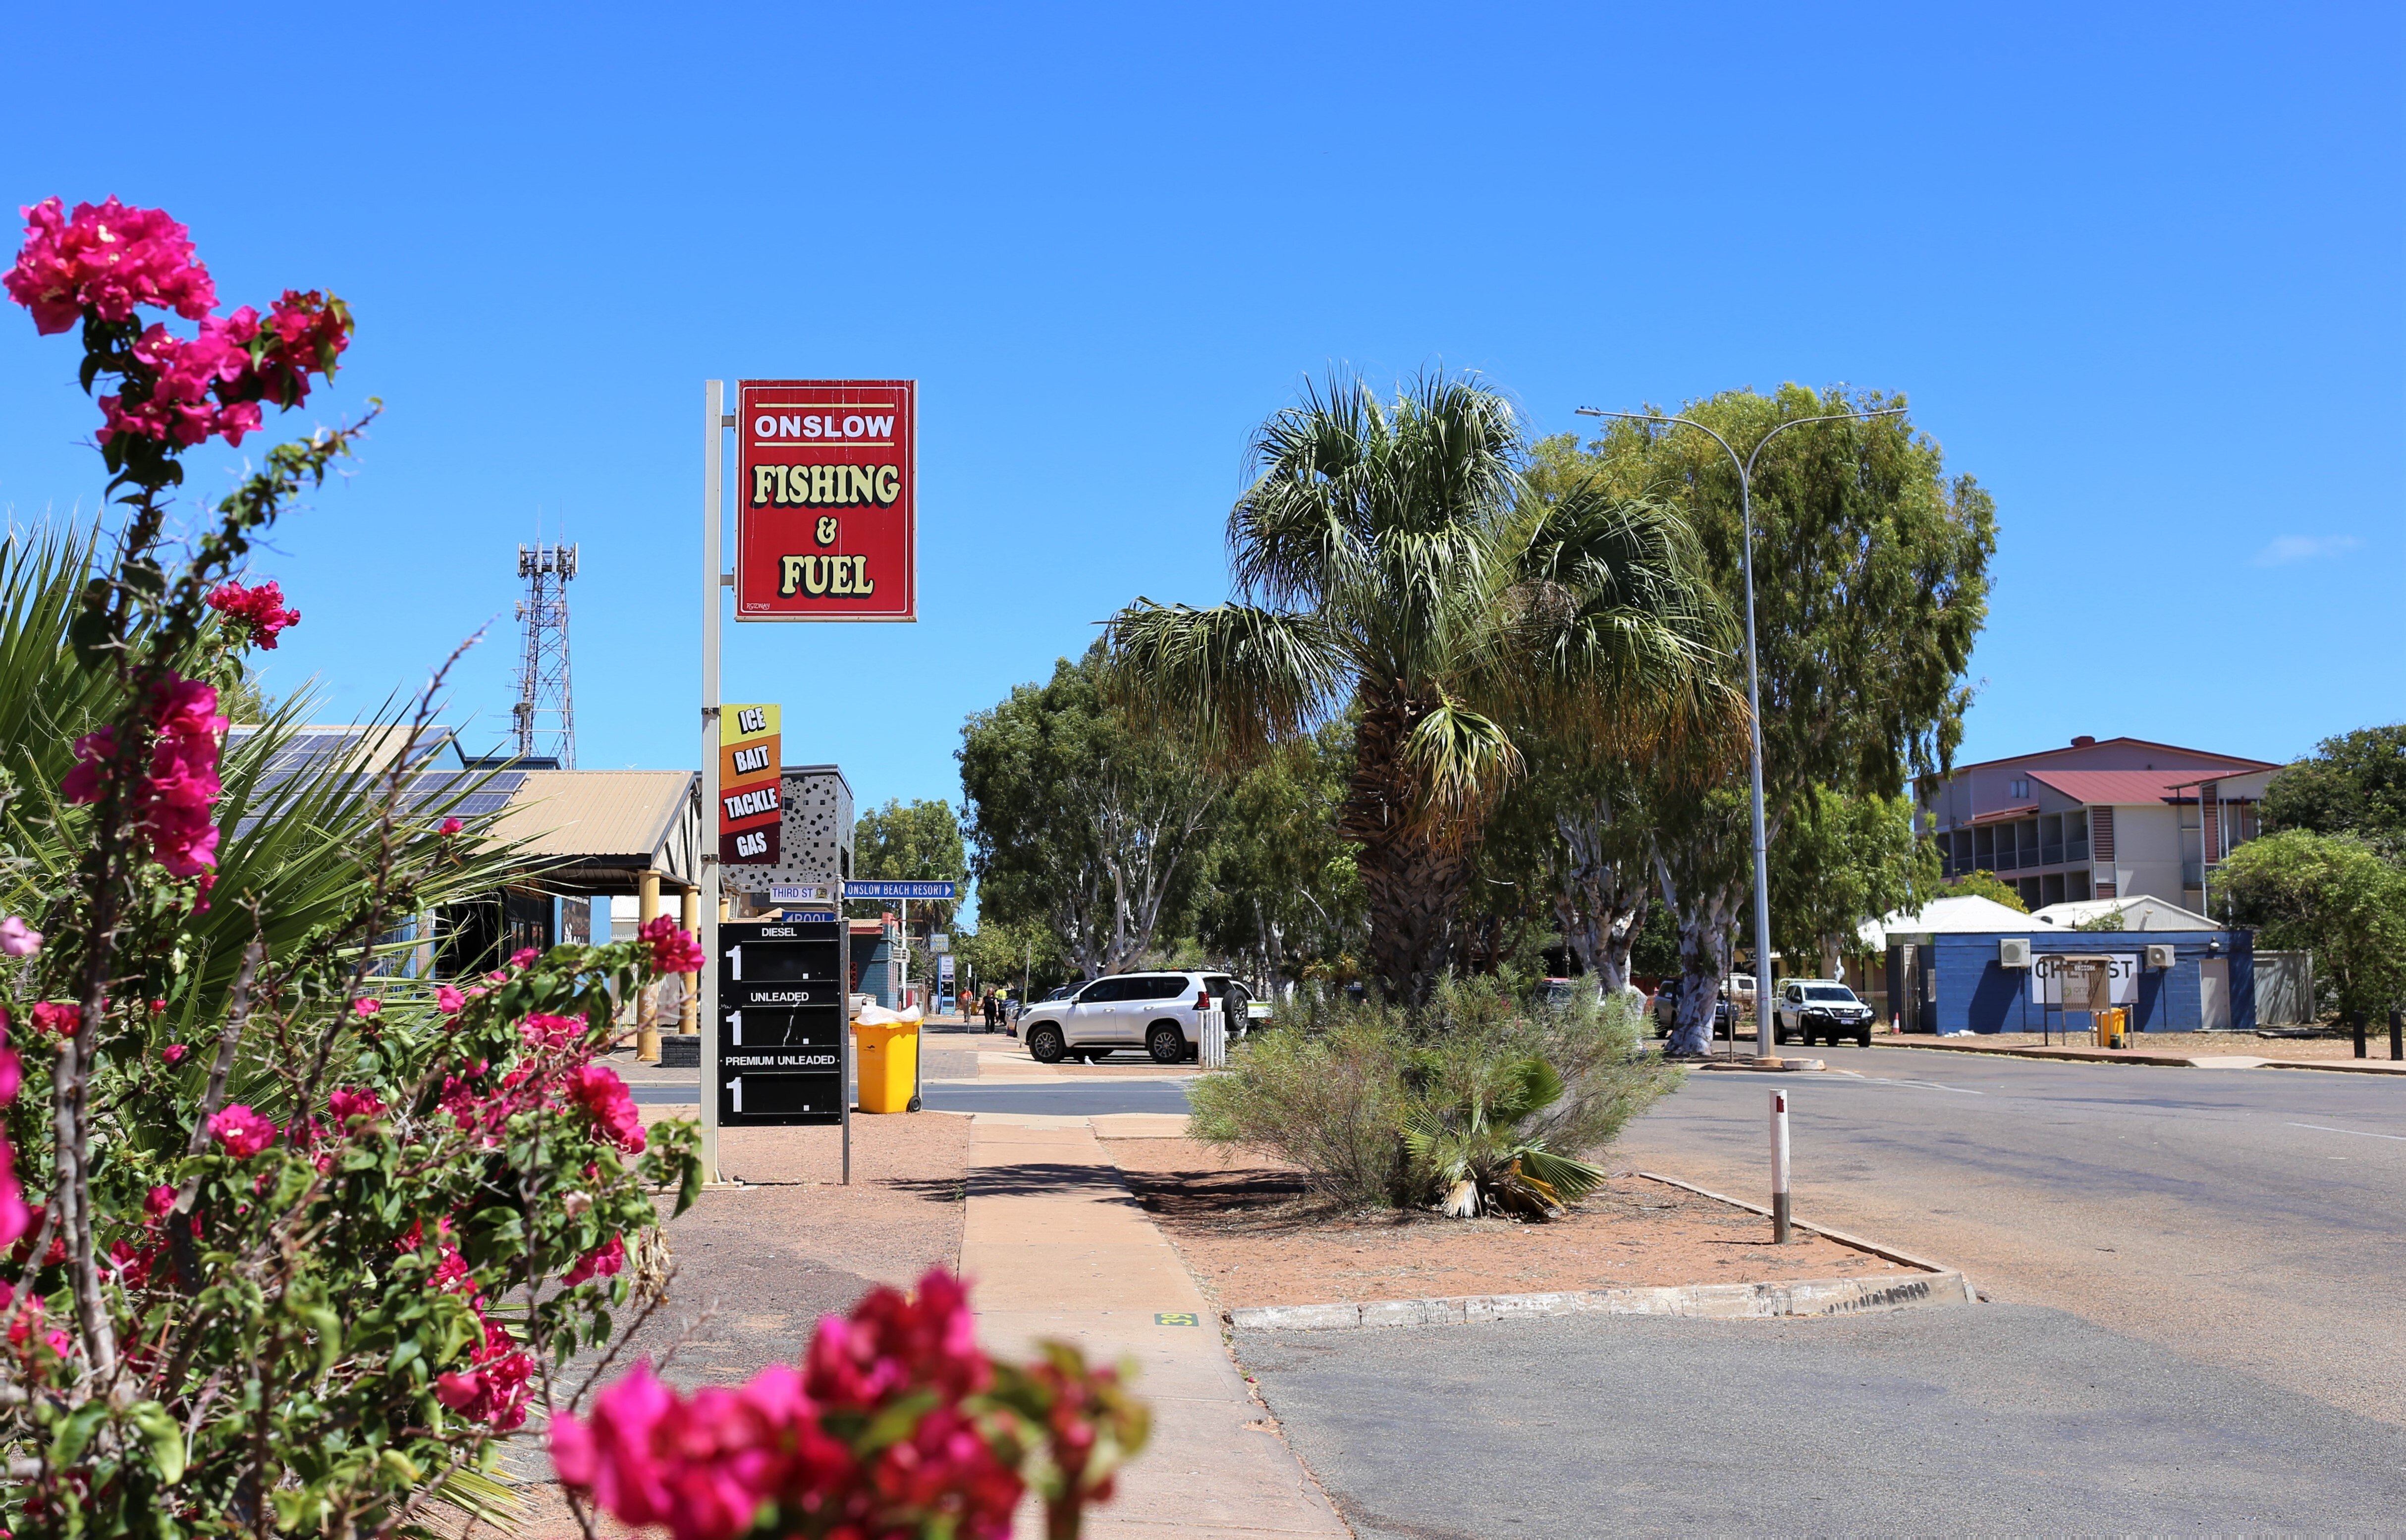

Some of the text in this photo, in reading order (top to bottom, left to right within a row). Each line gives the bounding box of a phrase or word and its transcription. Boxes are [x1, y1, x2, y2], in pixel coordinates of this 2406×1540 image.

[754, 415, 894, 438] ONSLOW
[753, 464, 901, 505] FISHING
[816, 516, 837, 545] &
[781, 555, 874, 595] FUEL
[739, 707, 766, 733] ICE
[734, 745, 769, 774] BAIT
[724, 787, 779, 820] TACKLE
[736, 831, 767, 858] GAS
[772, 888, 813, 898] THIRD ST
[847, 884, 942, 895] ONSLOW BEACH RESORT
[761, 927, 797, 937] DIESEL
[751, 992, 809, 1002] UNLEADED
[725, 1055, 835, 1066] PREMIUM UNLEADED
